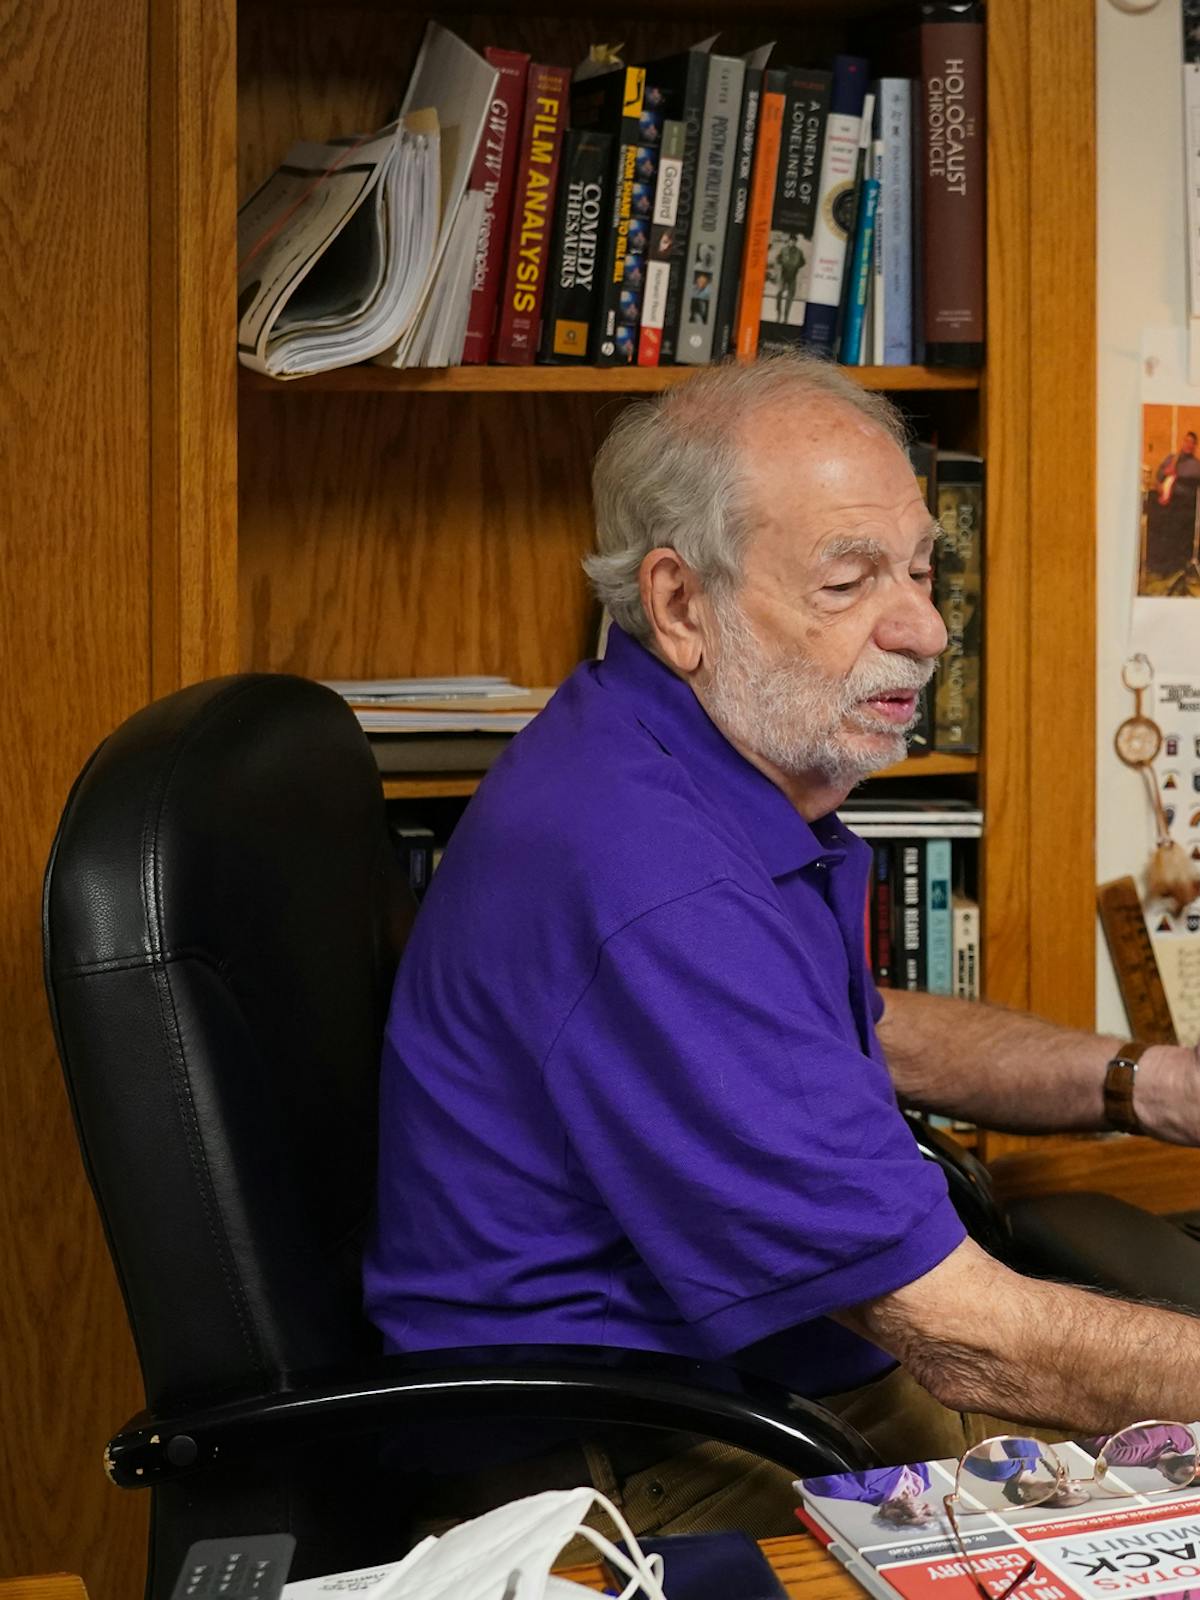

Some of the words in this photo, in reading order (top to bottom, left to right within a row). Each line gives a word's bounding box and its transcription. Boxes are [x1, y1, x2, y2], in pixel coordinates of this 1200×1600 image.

[807, 101, 820, 113] A
[926, 77, 945, 178] CHRONICLE
[944, 58, 967, 196] HOLOCAUST
[485, 99, 509, 174] GWTW
[530, 97, 559, 165] FILM
[712, 115, 729, 166] POSTWAR
[783, 102, 805, 200] LONELINESS
[801, 119, 820, 178] CINEMA
[625, 146, 637, 177] FROM
[737, 155, 752, 180] YORK
[620, 178, 634, 219] SHANE
[659, 165, 680, 223] Godard
[701, 167, 723, 232] HOLLYWOOD
[732, 187, 748, 224] CORKIN
[799, 183, 813, 205] OF
[513, 168, 551, 314] ANALYSIS
[560, 182, 585, 290] THESAURUS
[575, 183, 602, 291] COMEDY
[616, 236, 628, 259] KILL
[619, 220, 630, 235] TO
[612, 259, 625, 283] BILL
[948, 610, 964, 656] GREAT
[948, 662, 963, 719] MOVIES
[903, 847, 918, 874] FILM
[903, 876, 918, 904] NOIR
[903, 907, 919, 950] READER
[927, 1552, 1026, 1582] CENTURY
